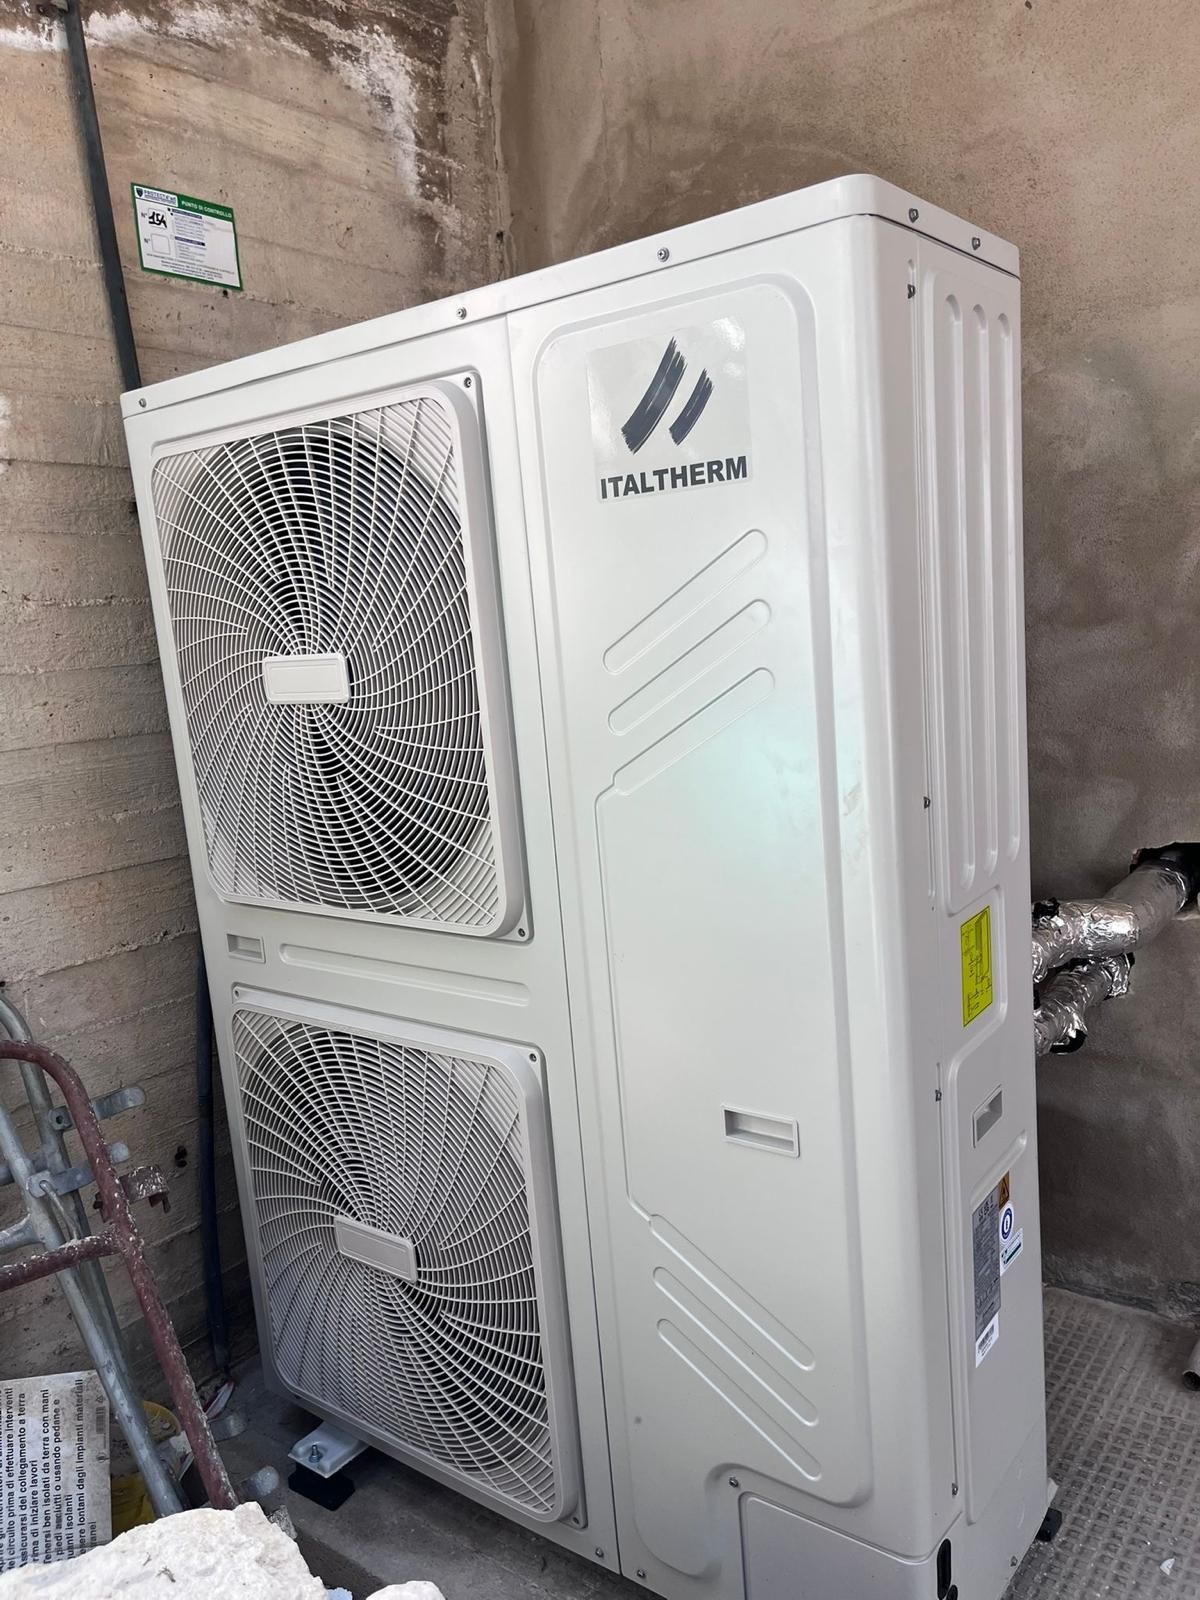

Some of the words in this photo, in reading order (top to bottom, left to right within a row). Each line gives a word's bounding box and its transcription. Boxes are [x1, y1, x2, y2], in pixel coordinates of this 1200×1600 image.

[148, 211, 168, 229] 154
[181, 201, 198, 210] PUNTO
[203, 207, 233, 218] CONTROLLO
[600, 455, 748, 500] ITALTHERM
[4, 1387, 14, 1432] interventi
[17, 1392, 26, 1417] terra
[40, 1389, 49, 1413] mani
[53, 1398, 60, 1406] e
[74, 1379, 84, 1422] materiali
[42, 1415, 50, 1434] con
[52, 1407, 62, 1443] pedane
[5, 1433, 14, 1478] effettuare
[41, 1436, 50, 1460] terra
[74, 1424, 86, 1464] impianti
[17, 1427, 28, 1493] collegamento
[41, 1462, 50, 1474] da
[52, 1446, 61, 1482] usando
[5, 1479, 14, 1489] di
[28, 1459, 38, 1488] lavori
[75, 1465, 87, 1490] dagli
[41, 1476, 50, 1507] isolati
[54, 1484, 62, 1492] o
[6, 1491, 16, 1518] prima
[18, 1495, 27, 1511] del
[29, 1489, 39, 1526] iniziare
[64, 1494, 73, 1530] isolanti
[76, 1492, 85, 1526] lontani
[42, 1509, 51, 1528] ben
[6, 1520, 15, 1556] circuito
[30, 1528, 39, 1538] di
[53, 1532, 64, 1556] piedi
[30, 1540, 39, 1562] rima
